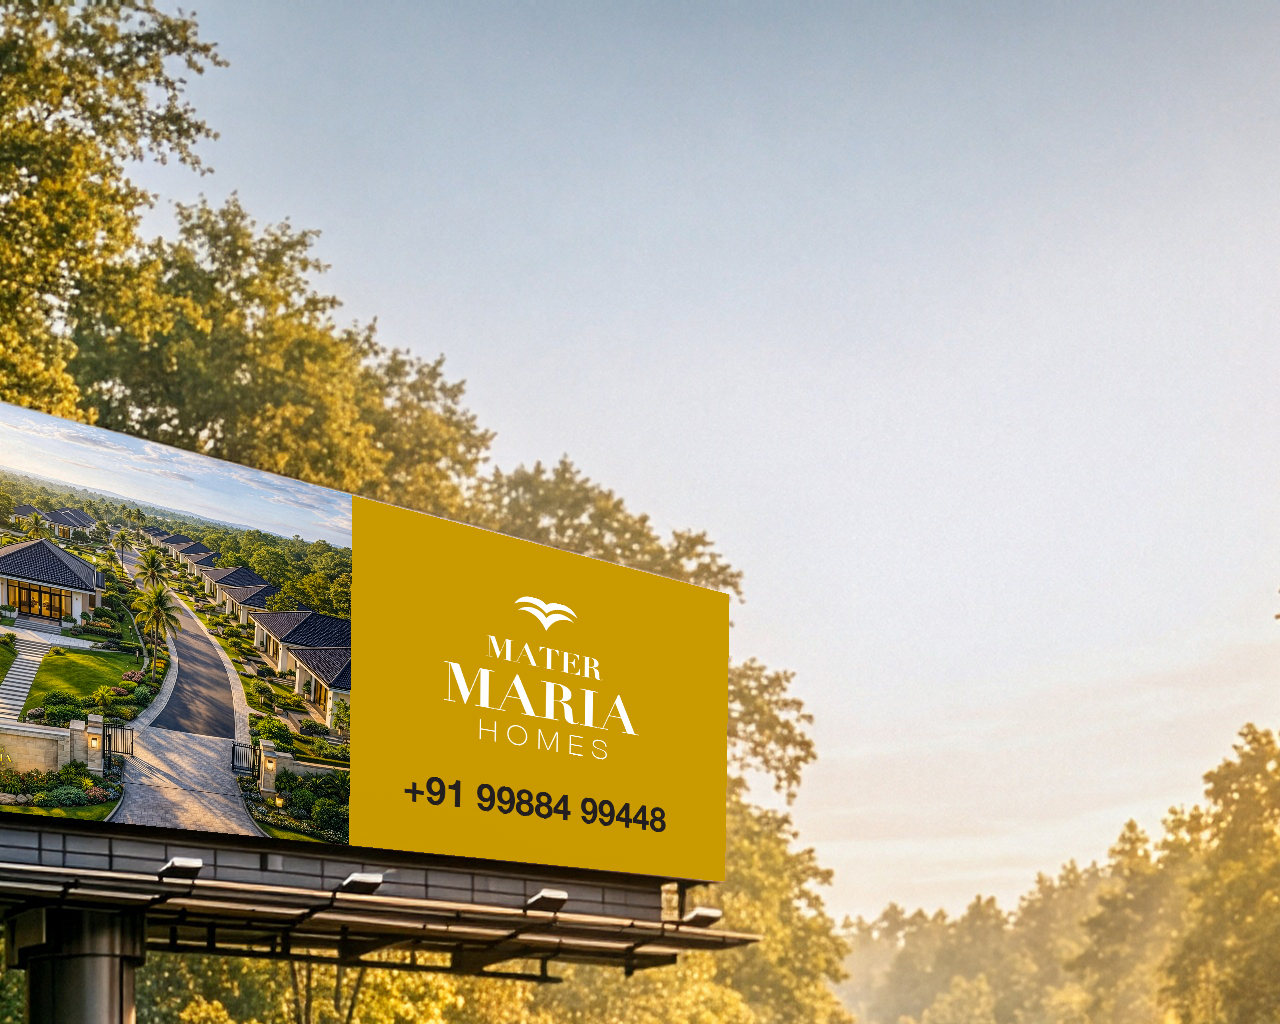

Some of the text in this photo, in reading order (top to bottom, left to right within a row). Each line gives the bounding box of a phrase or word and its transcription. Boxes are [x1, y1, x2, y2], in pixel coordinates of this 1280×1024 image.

[485, 634, 603, 681] MATER
[443, 660, 640, 737] MARIA
[478, 718, 609, 761] HOMES
[404, 776, 667, 833] +91 99884 99448
